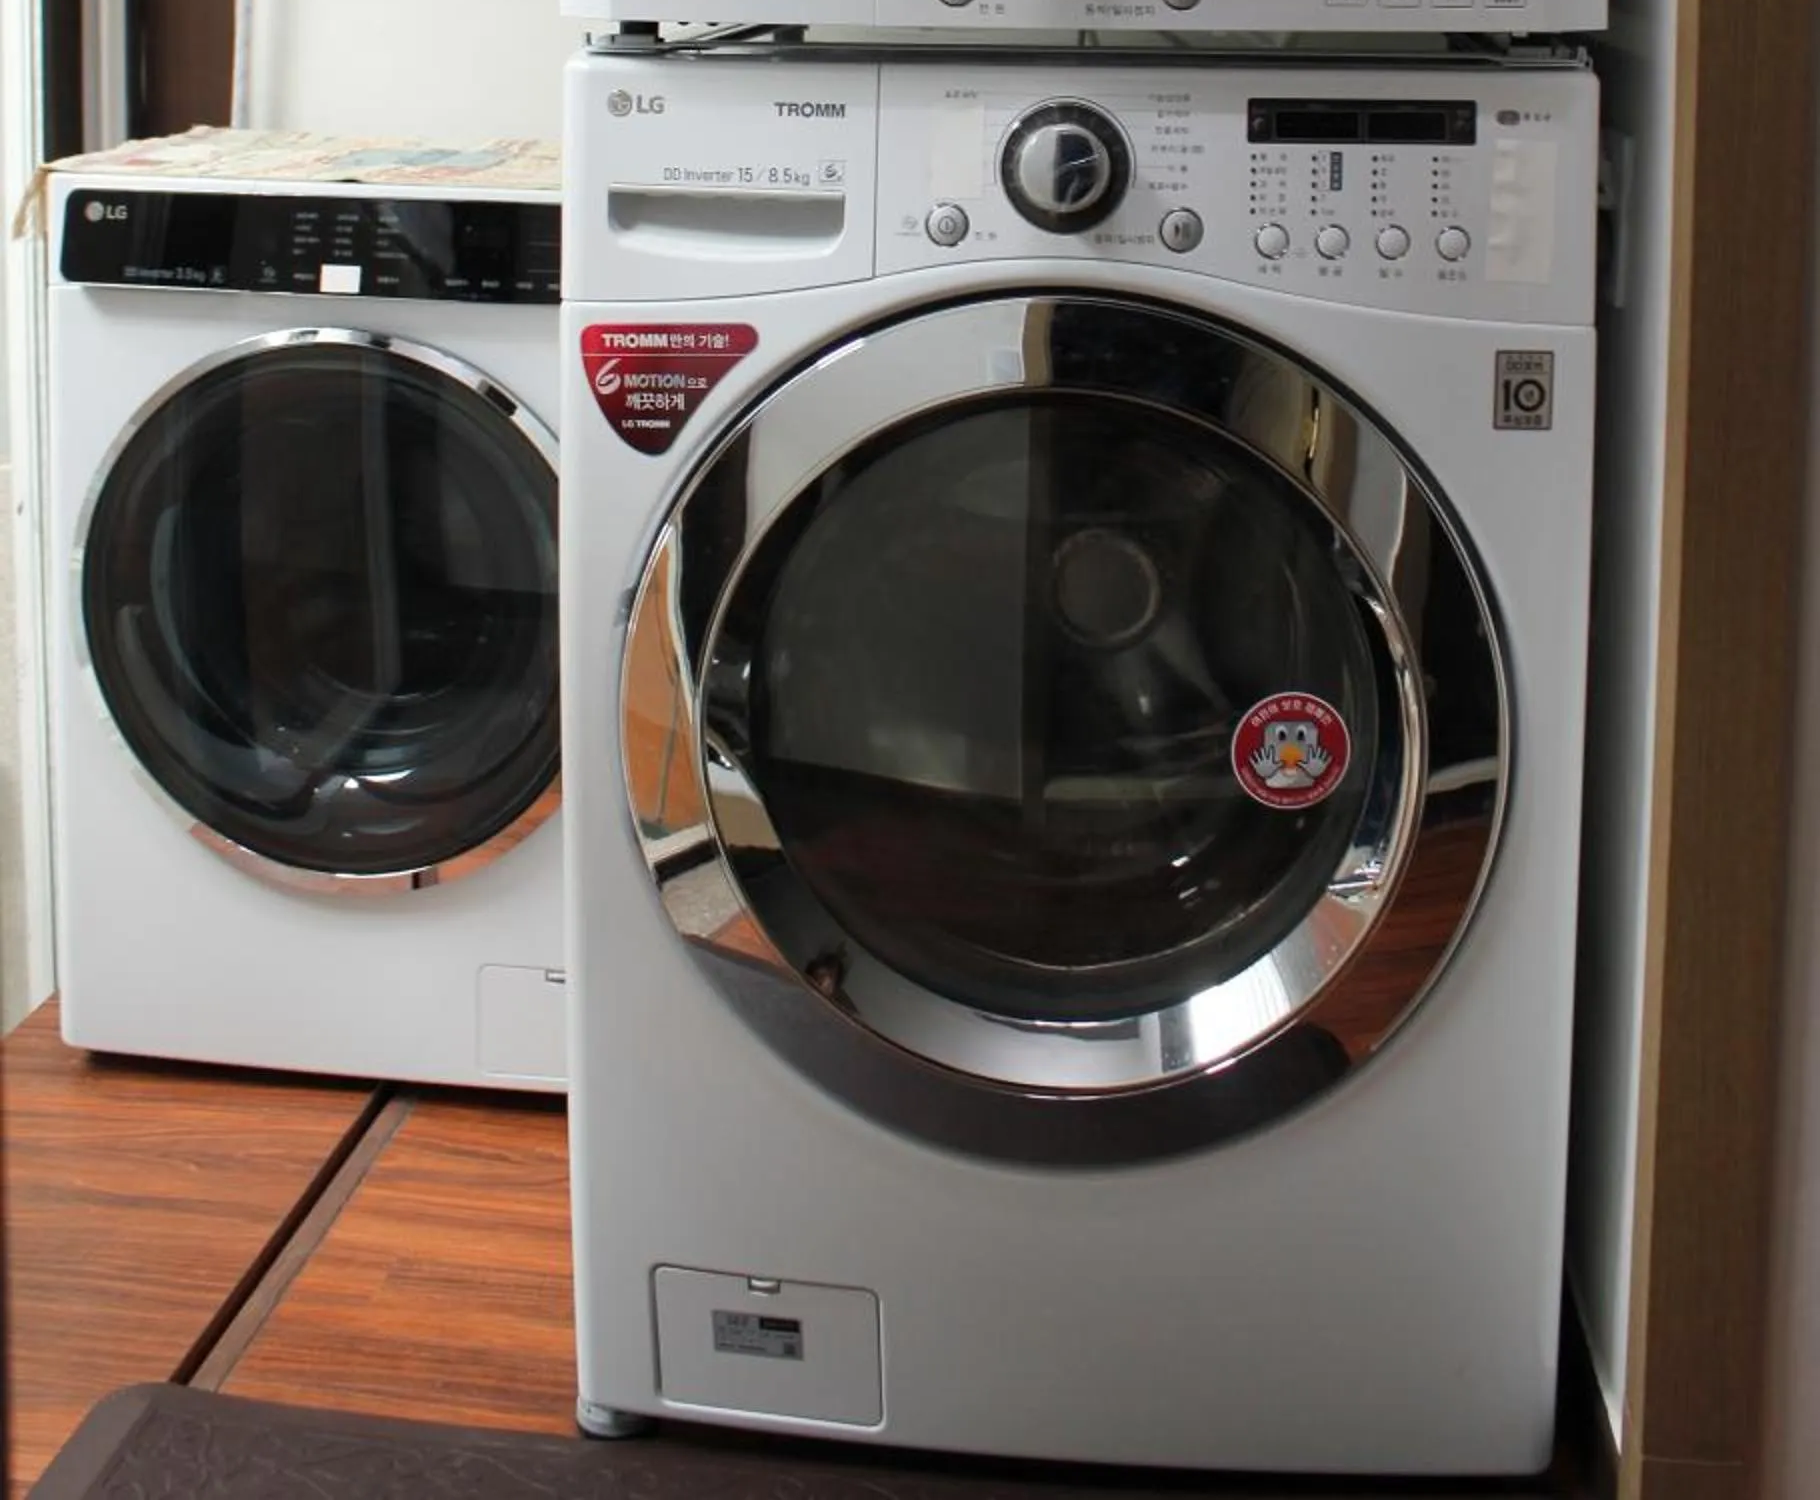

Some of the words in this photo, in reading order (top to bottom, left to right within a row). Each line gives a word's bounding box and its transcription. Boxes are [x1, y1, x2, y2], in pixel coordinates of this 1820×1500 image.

[636, 95, 665, 114] LG
[774, 101, 846, 118] TROMM
[683, 167, 733, 183] Inverter
[737, 167, 753, 183] 15
[105, 204, 129, 220] LG
[625, 392, 685, 411] 깨끗하게
